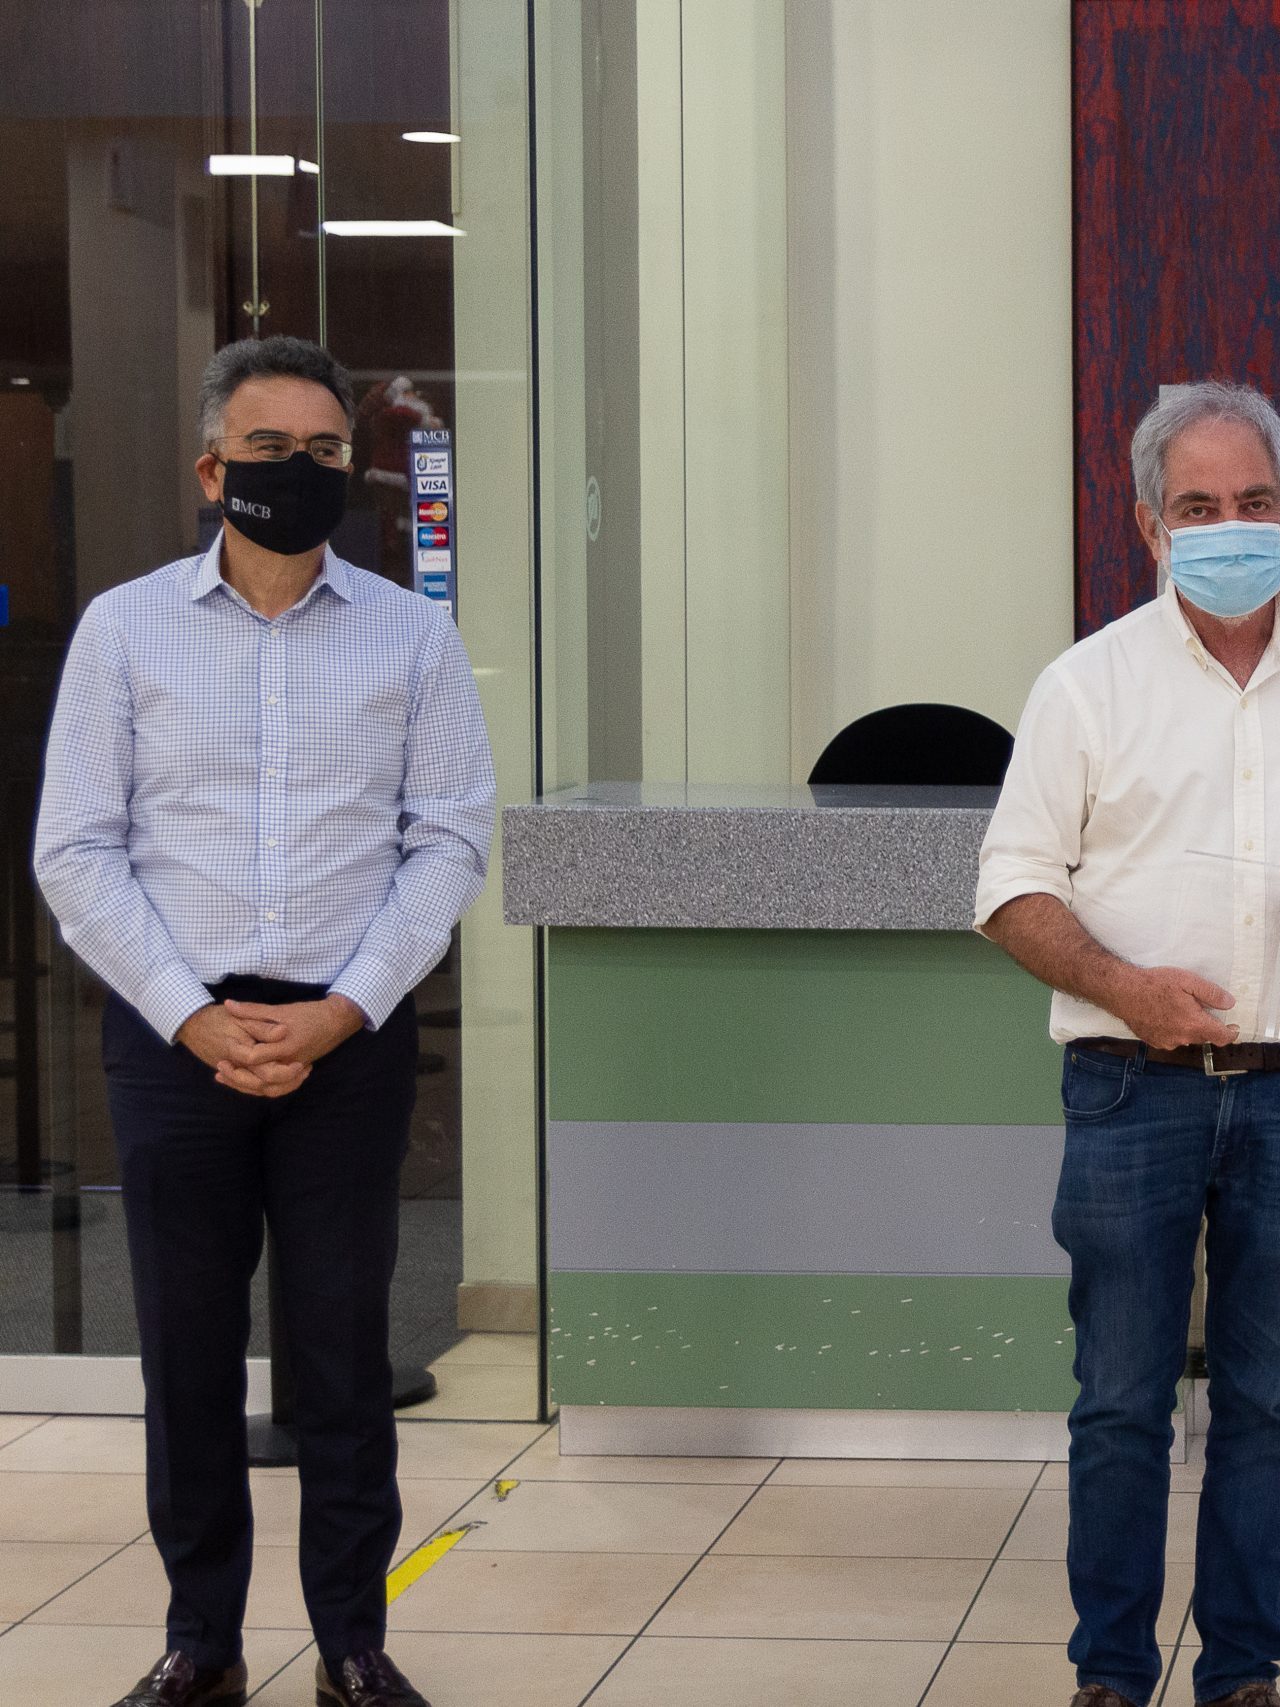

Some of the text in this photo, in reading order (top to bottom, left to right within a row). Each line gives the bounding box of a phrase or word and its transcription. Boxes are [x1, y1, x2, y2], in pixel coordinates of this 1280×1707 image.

[424, 430, 450, 441] MCB
[421, 480, 447, 490] VISA
[240, 500, 271, 519] MCB
